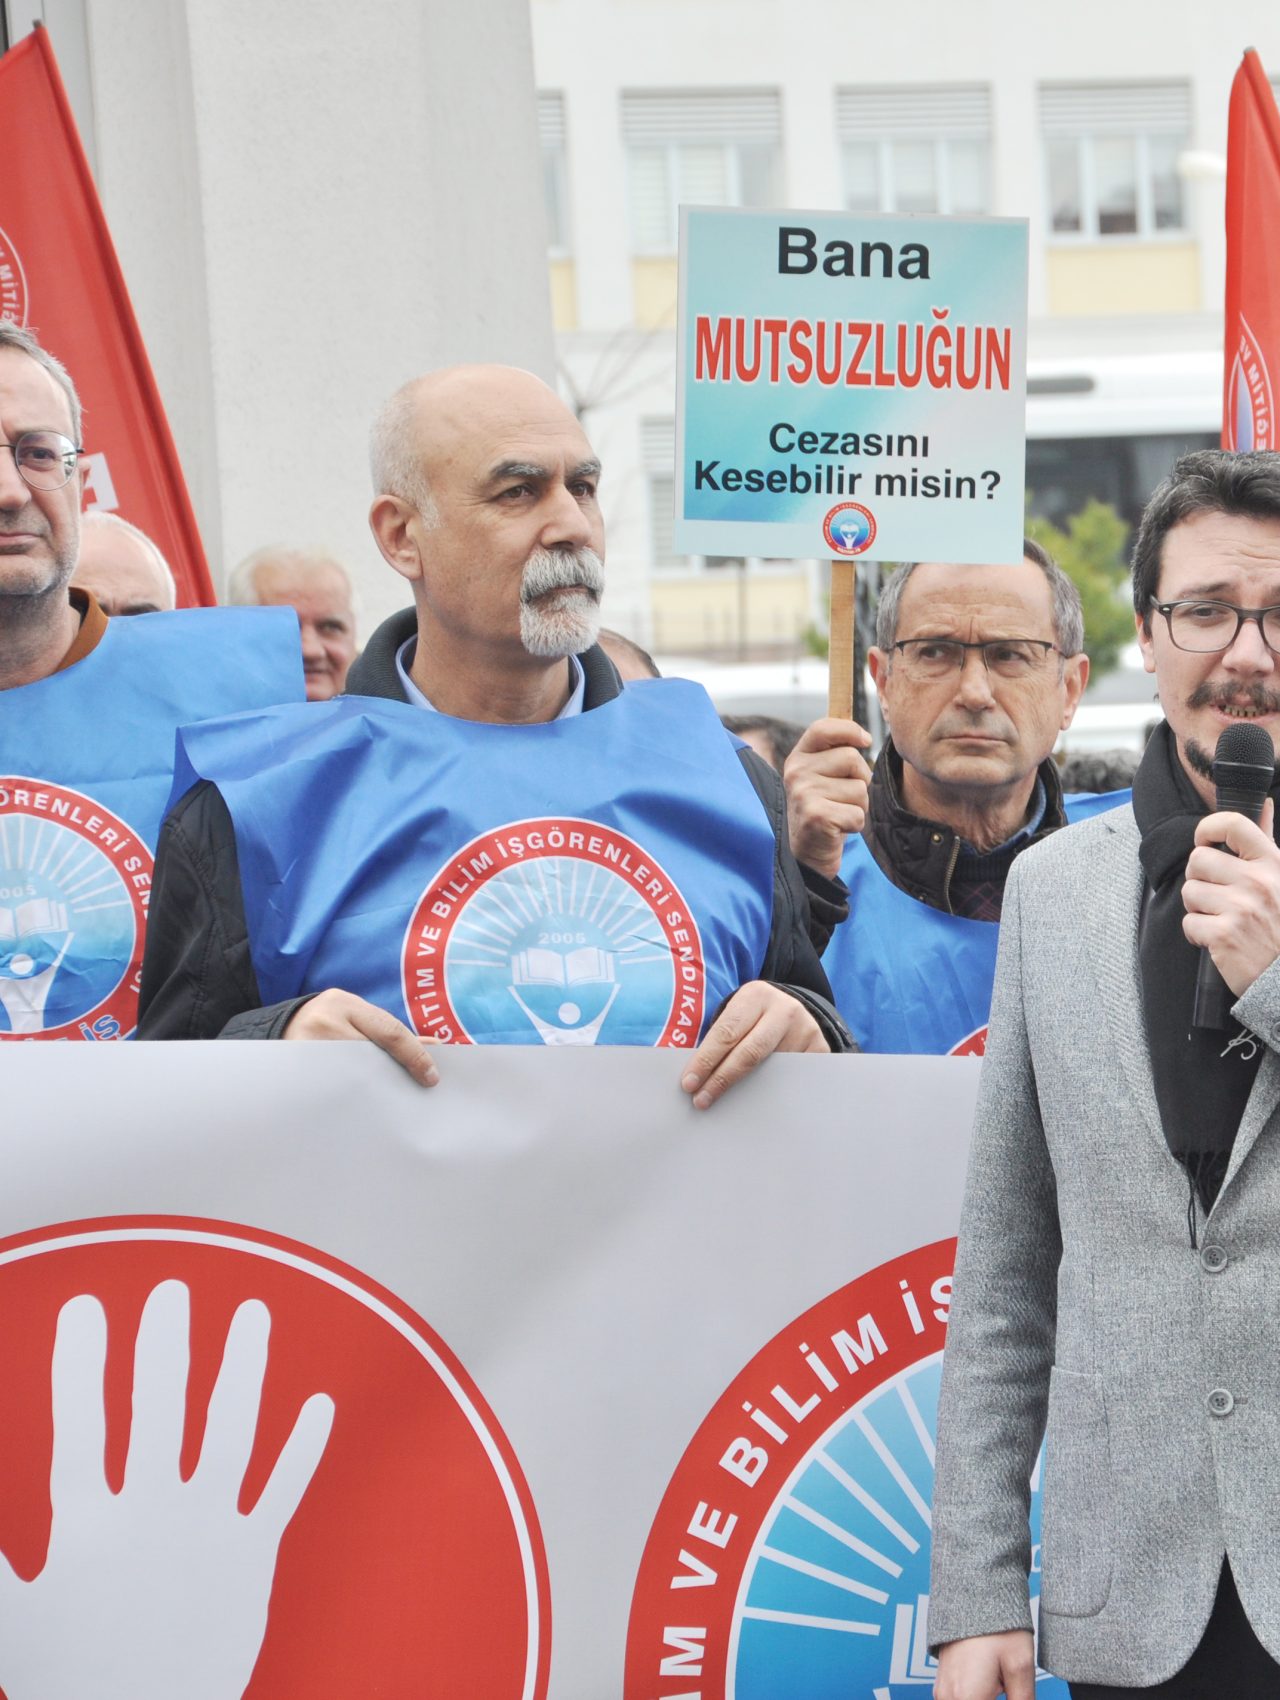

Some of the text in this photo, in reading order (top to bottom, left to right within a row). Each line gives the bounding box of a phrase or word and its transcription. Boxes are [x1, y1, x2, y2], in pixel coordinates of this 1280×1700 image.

[778, 226, 931, 280] Bana
[694, 306, 1011, 391] MUTSUZLUĞUN
[769, 422, 929, 458] Cezasını
[694, 459, 1001, 500] Kesebilir misin?
[431, 851, 494, 919] BİLİM
[495, 825, 674, 906] İŞGÖRENLERİ
[416, 924, 441, 957] VE
[537, 931, 588, 945] 2005
[414, 968, 453, 1044] ĞİTİM
[669, 1501, 739, 1590] VE
[717, 1312, 890, 1489] BİLİM
